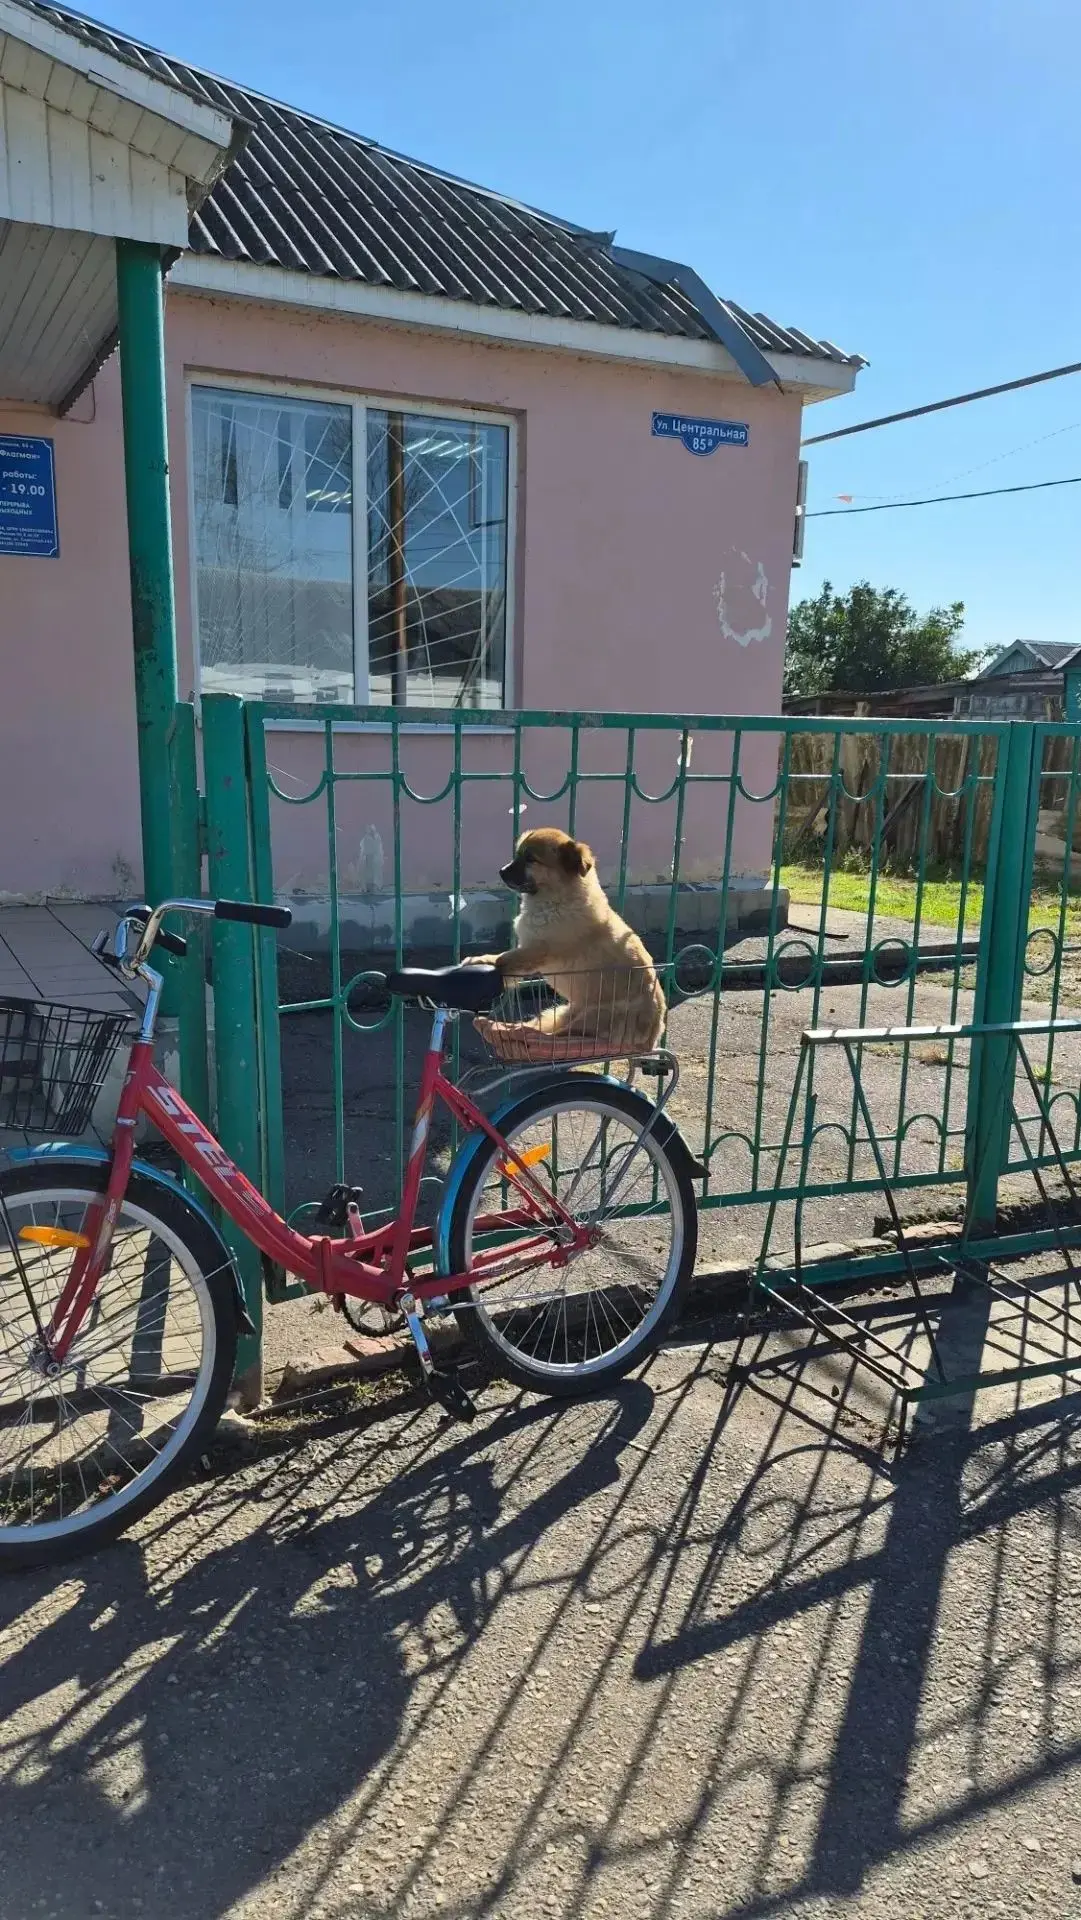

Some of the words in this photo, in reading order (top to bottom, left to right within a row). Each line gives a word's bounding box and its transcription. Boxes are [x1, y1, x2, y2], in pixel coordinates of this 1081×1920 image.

[672, 420, 745, 439] Центральная
[2, 471, 37, 479] работы:
[11, 483, 46, 497] 19.00
